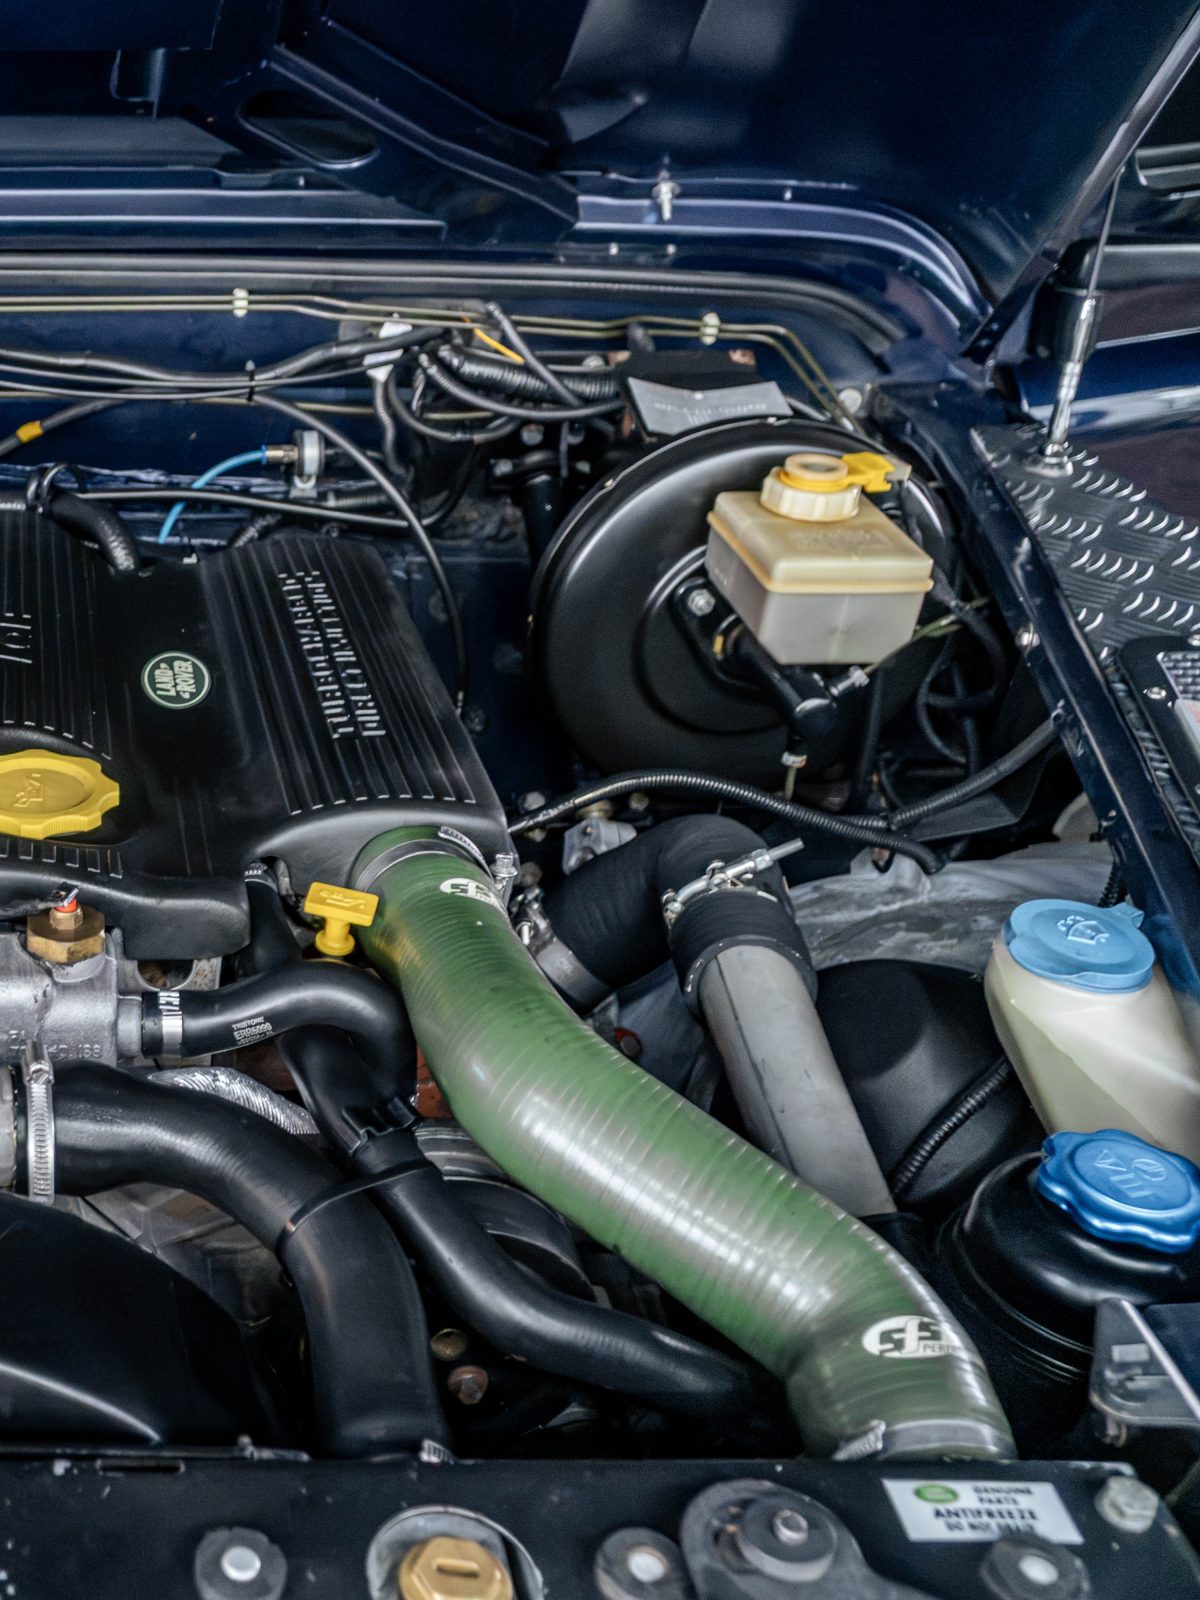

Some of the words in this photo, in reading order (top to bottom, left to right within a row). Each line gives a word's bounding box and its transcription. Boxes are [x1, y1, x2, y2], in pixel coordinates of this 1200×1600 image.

[154, 668, 177, 697] LAND
[173, 660, 197, 693] ROVER
[932, 1507, 1039, 1521] ANTIFREEZE
